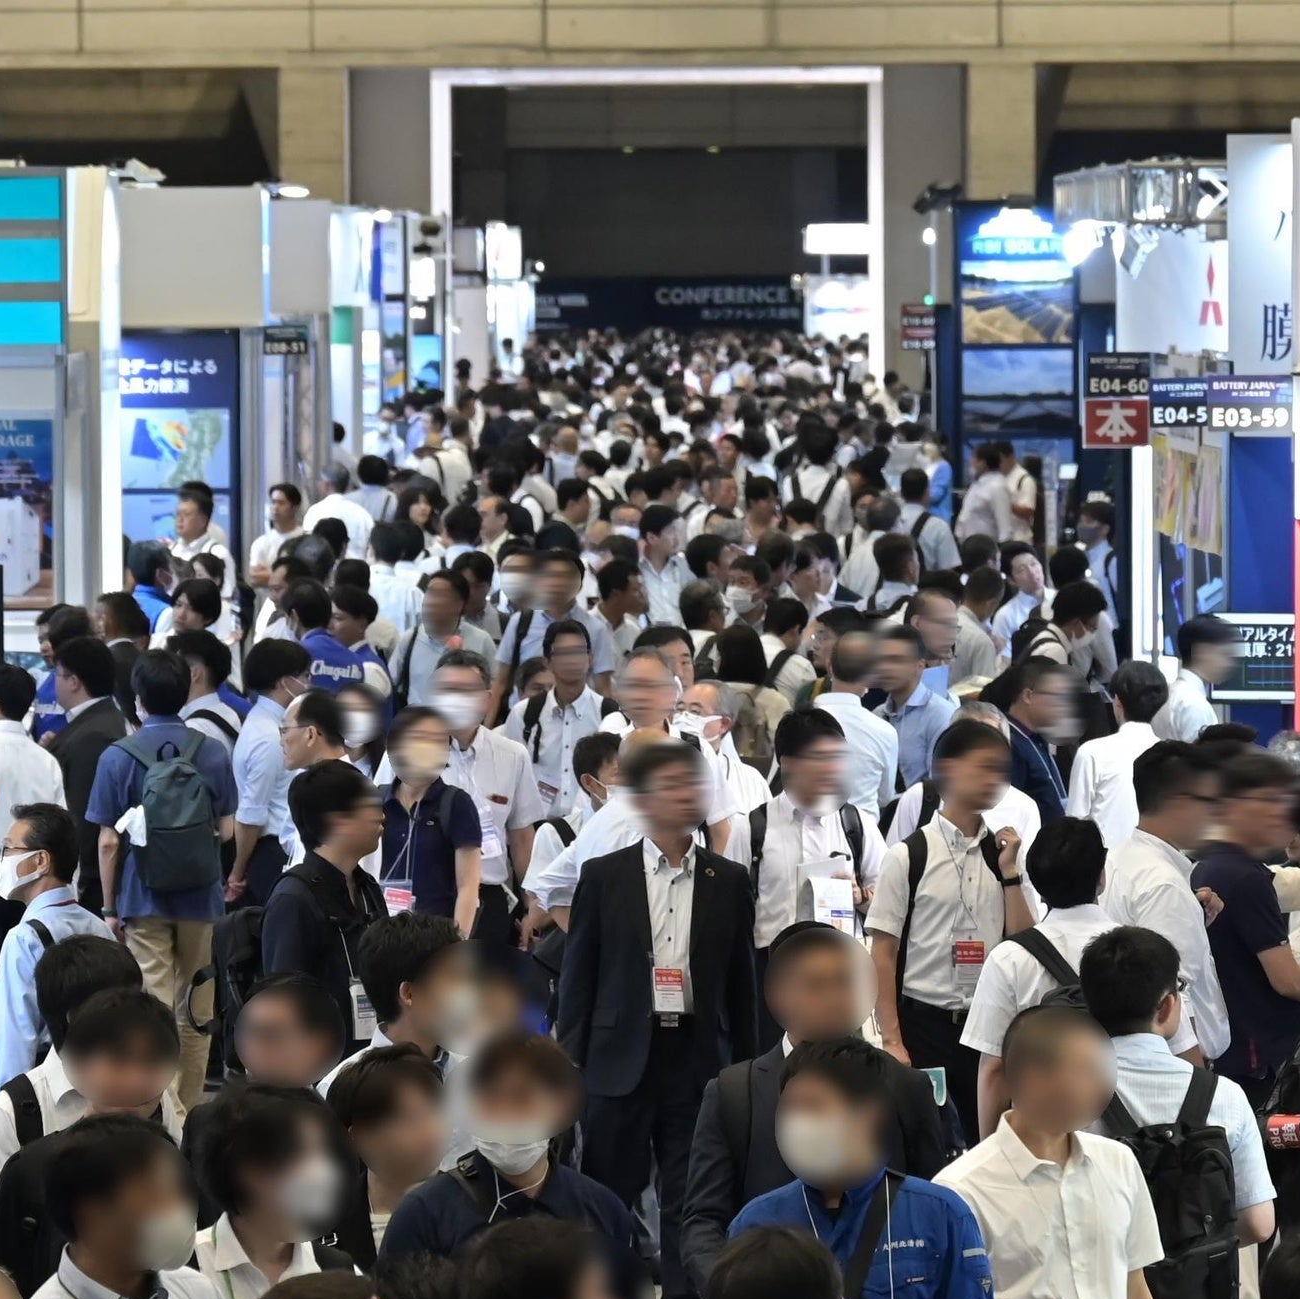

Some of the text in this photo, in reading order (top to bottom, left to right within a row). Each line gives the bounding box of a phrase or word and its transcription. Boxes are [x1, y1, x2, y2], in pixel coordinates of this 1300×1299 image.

[1089, 376, 1149, 394] E04-60
[1212, 381, 1276, 391] BATTERY JAPAN
[1095, 401, 1138, 443] 本
[1211, 407, 1289, 428] E03-59
